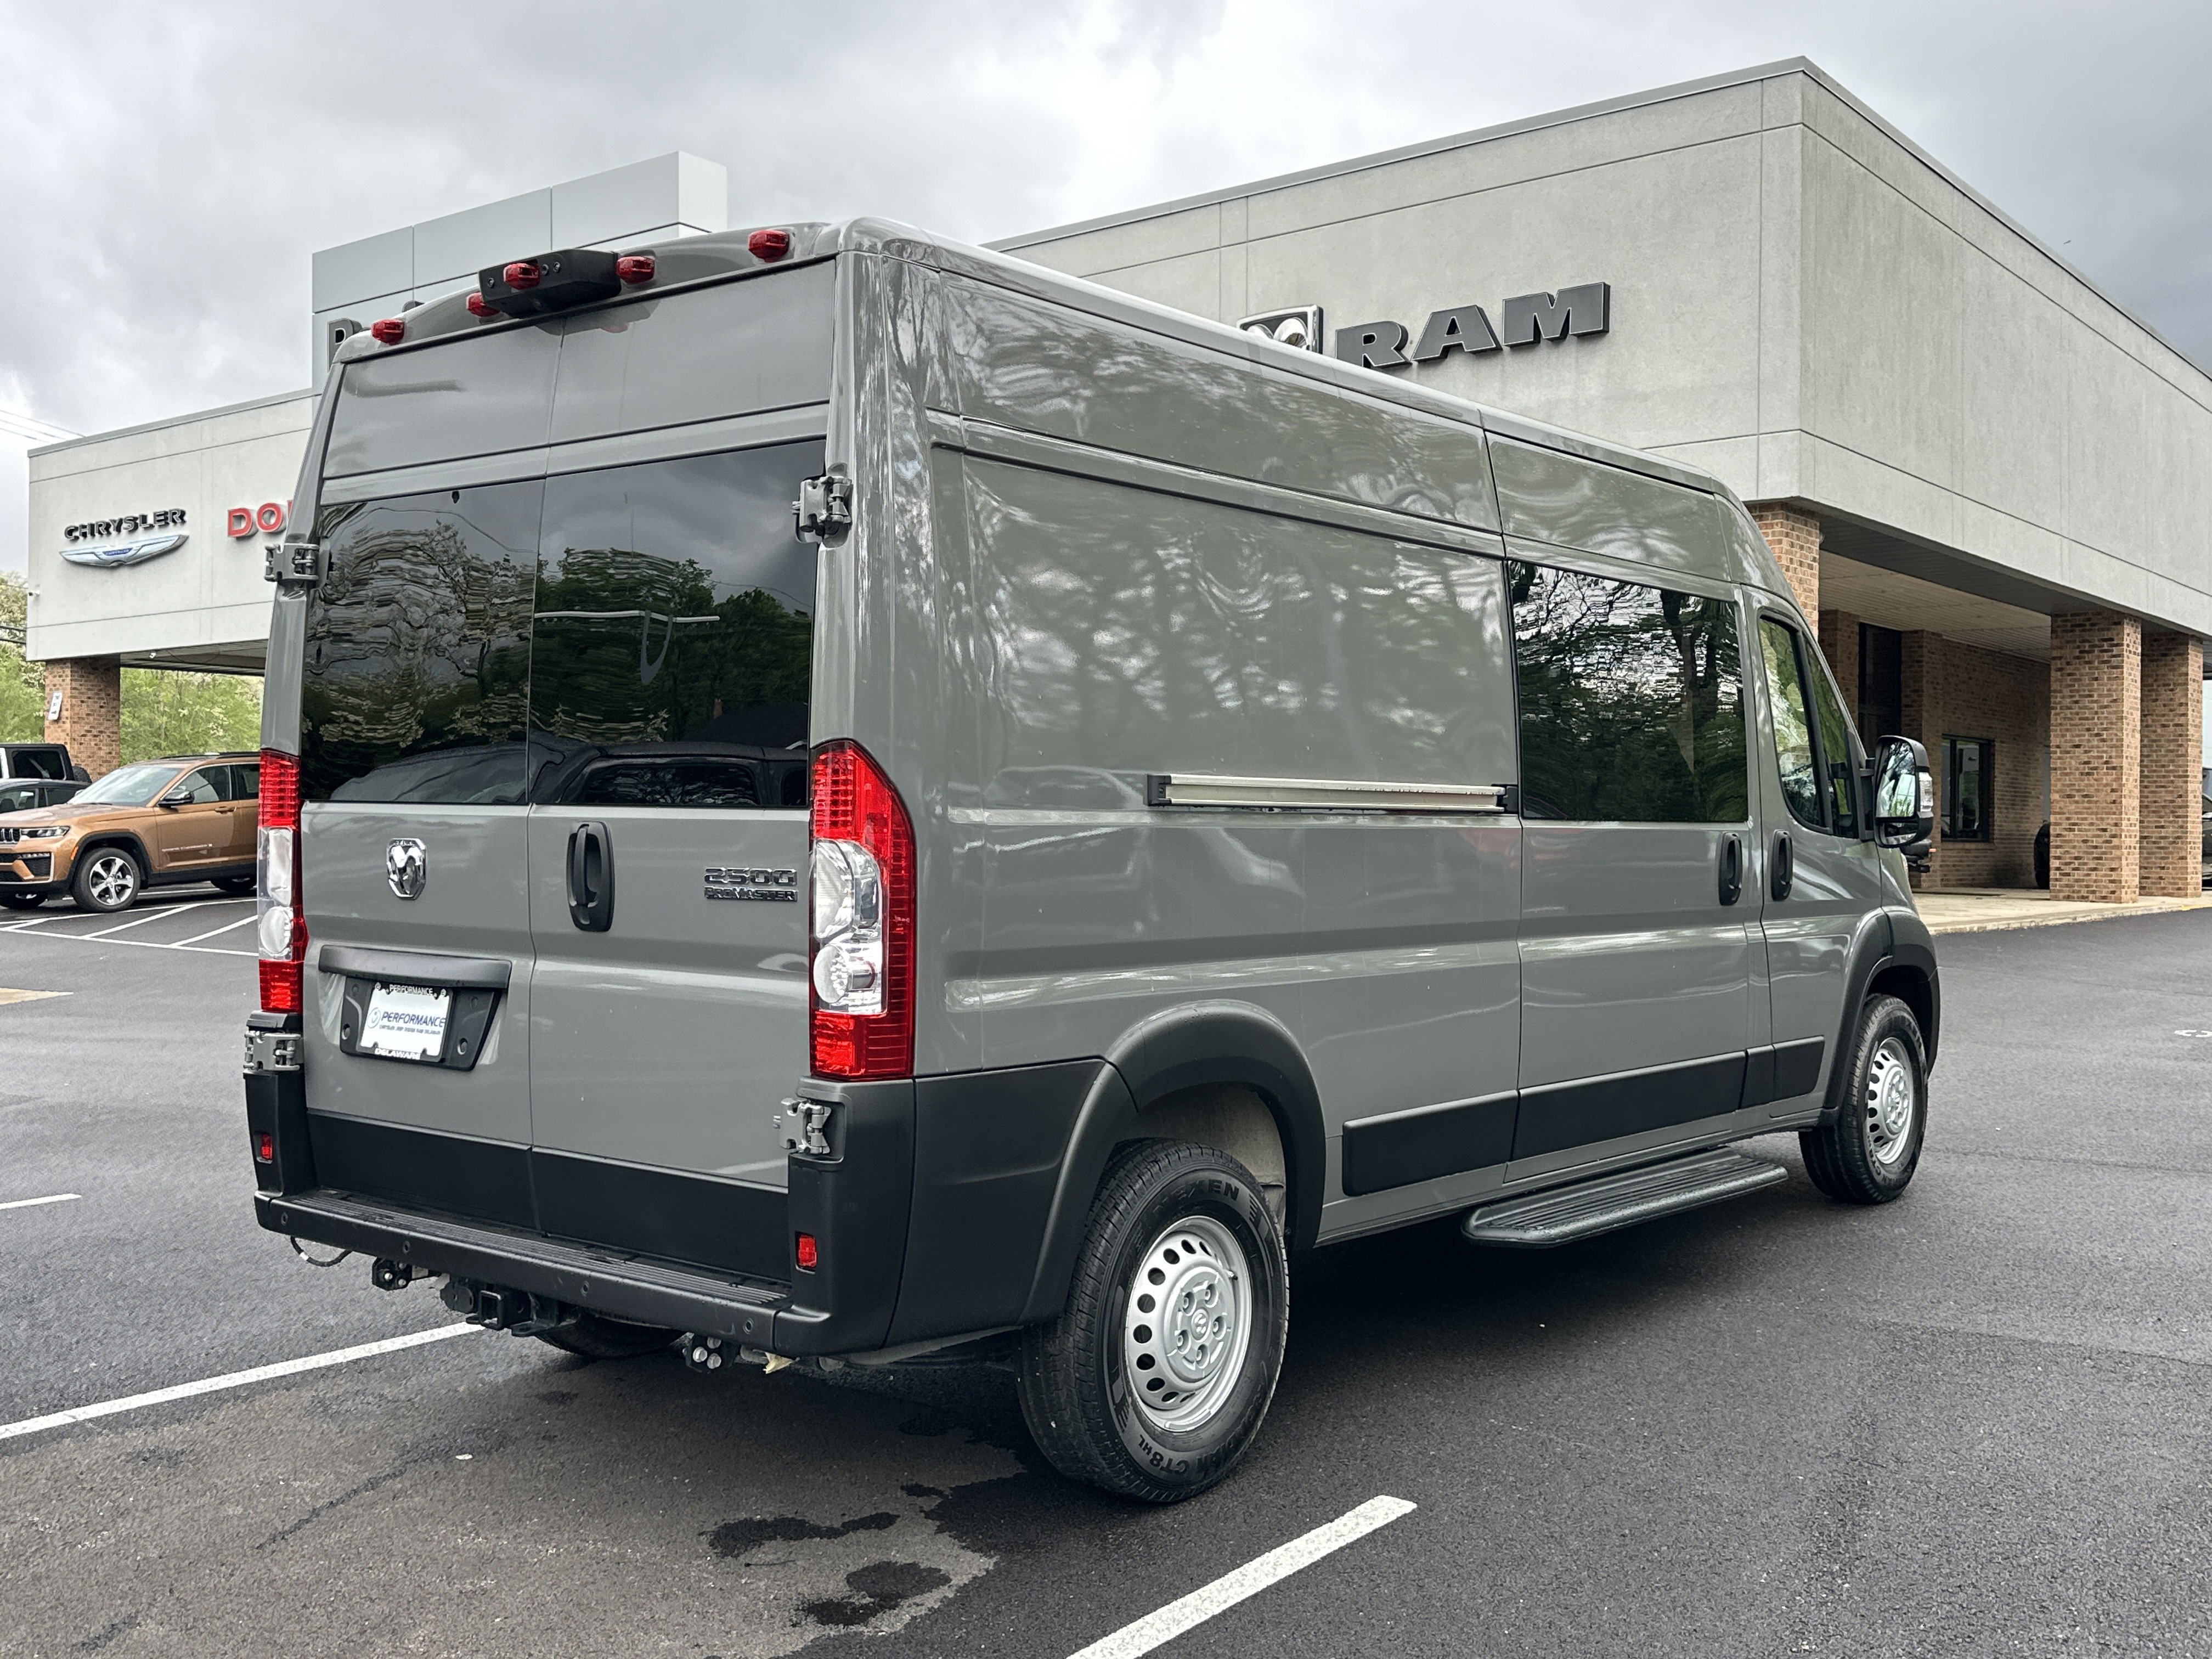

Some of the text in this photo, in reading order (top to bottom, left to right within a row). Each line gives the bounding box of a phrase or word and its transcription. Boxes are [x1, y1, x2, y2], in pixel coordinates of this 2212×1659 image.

[1335, 281, 1610, 368] RAM
[64, 508, 185, 540] CHRYSLER
[227, 499, 294, 538] DO
[704, 867, 797, 885] 2500
[381, 1011, 446, 1028] PERFORMANCE
